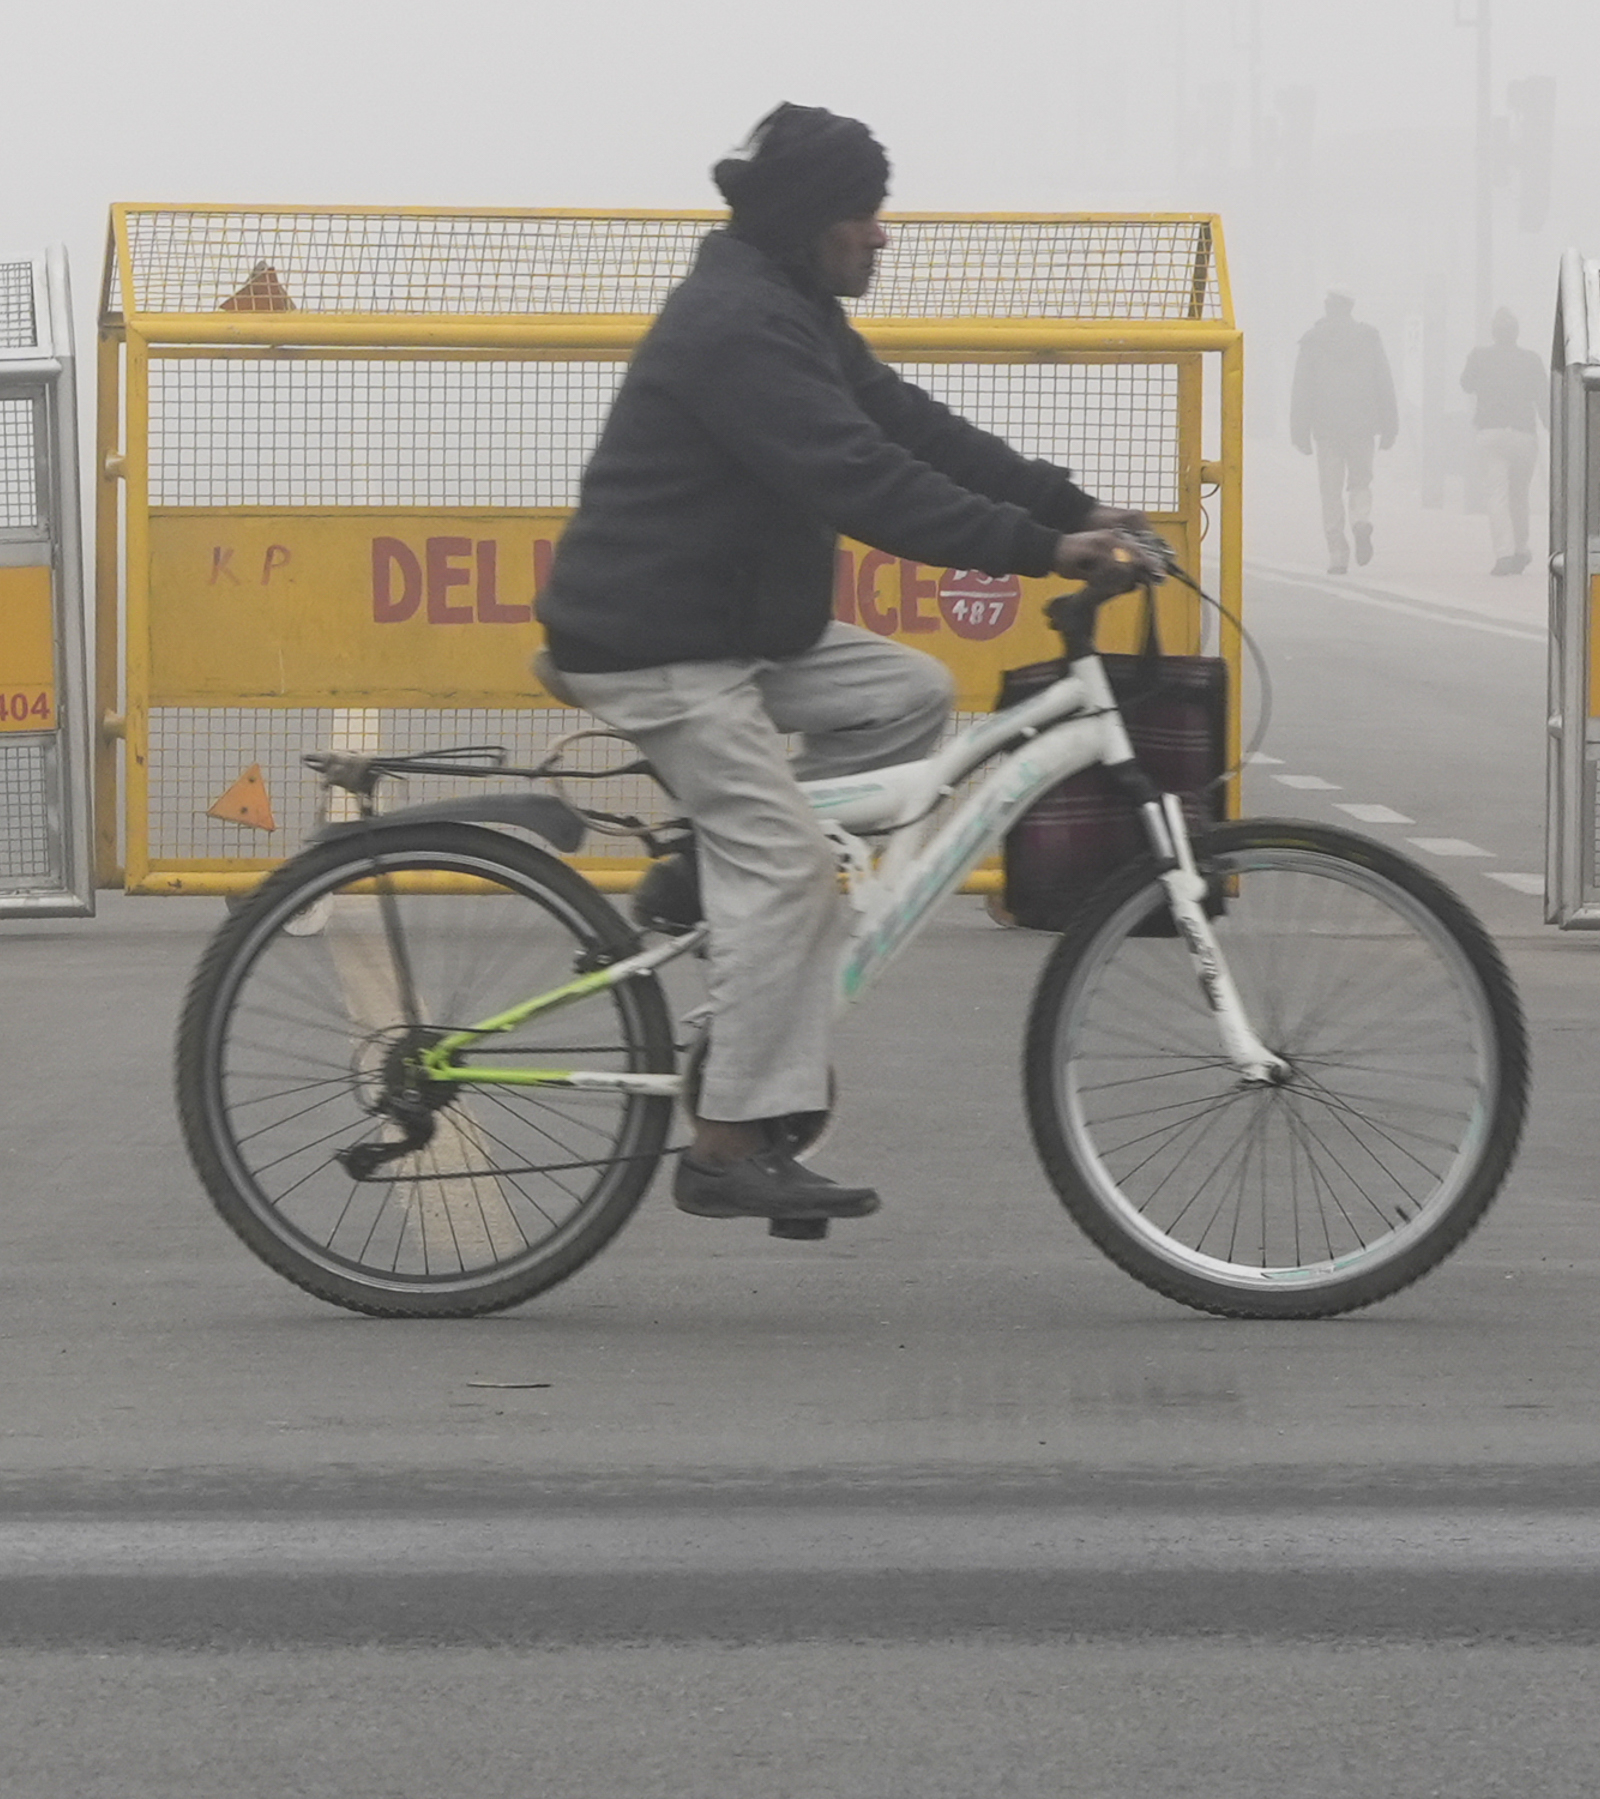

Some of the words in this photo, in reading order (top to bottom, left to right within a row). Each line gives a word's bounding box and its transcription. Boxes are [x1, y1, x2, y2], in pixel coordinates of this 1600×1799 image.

[371, 536, 554, 625] DEL
[834, 548, 941, 637] ICE
[951, 599, 1004, 625] 487
